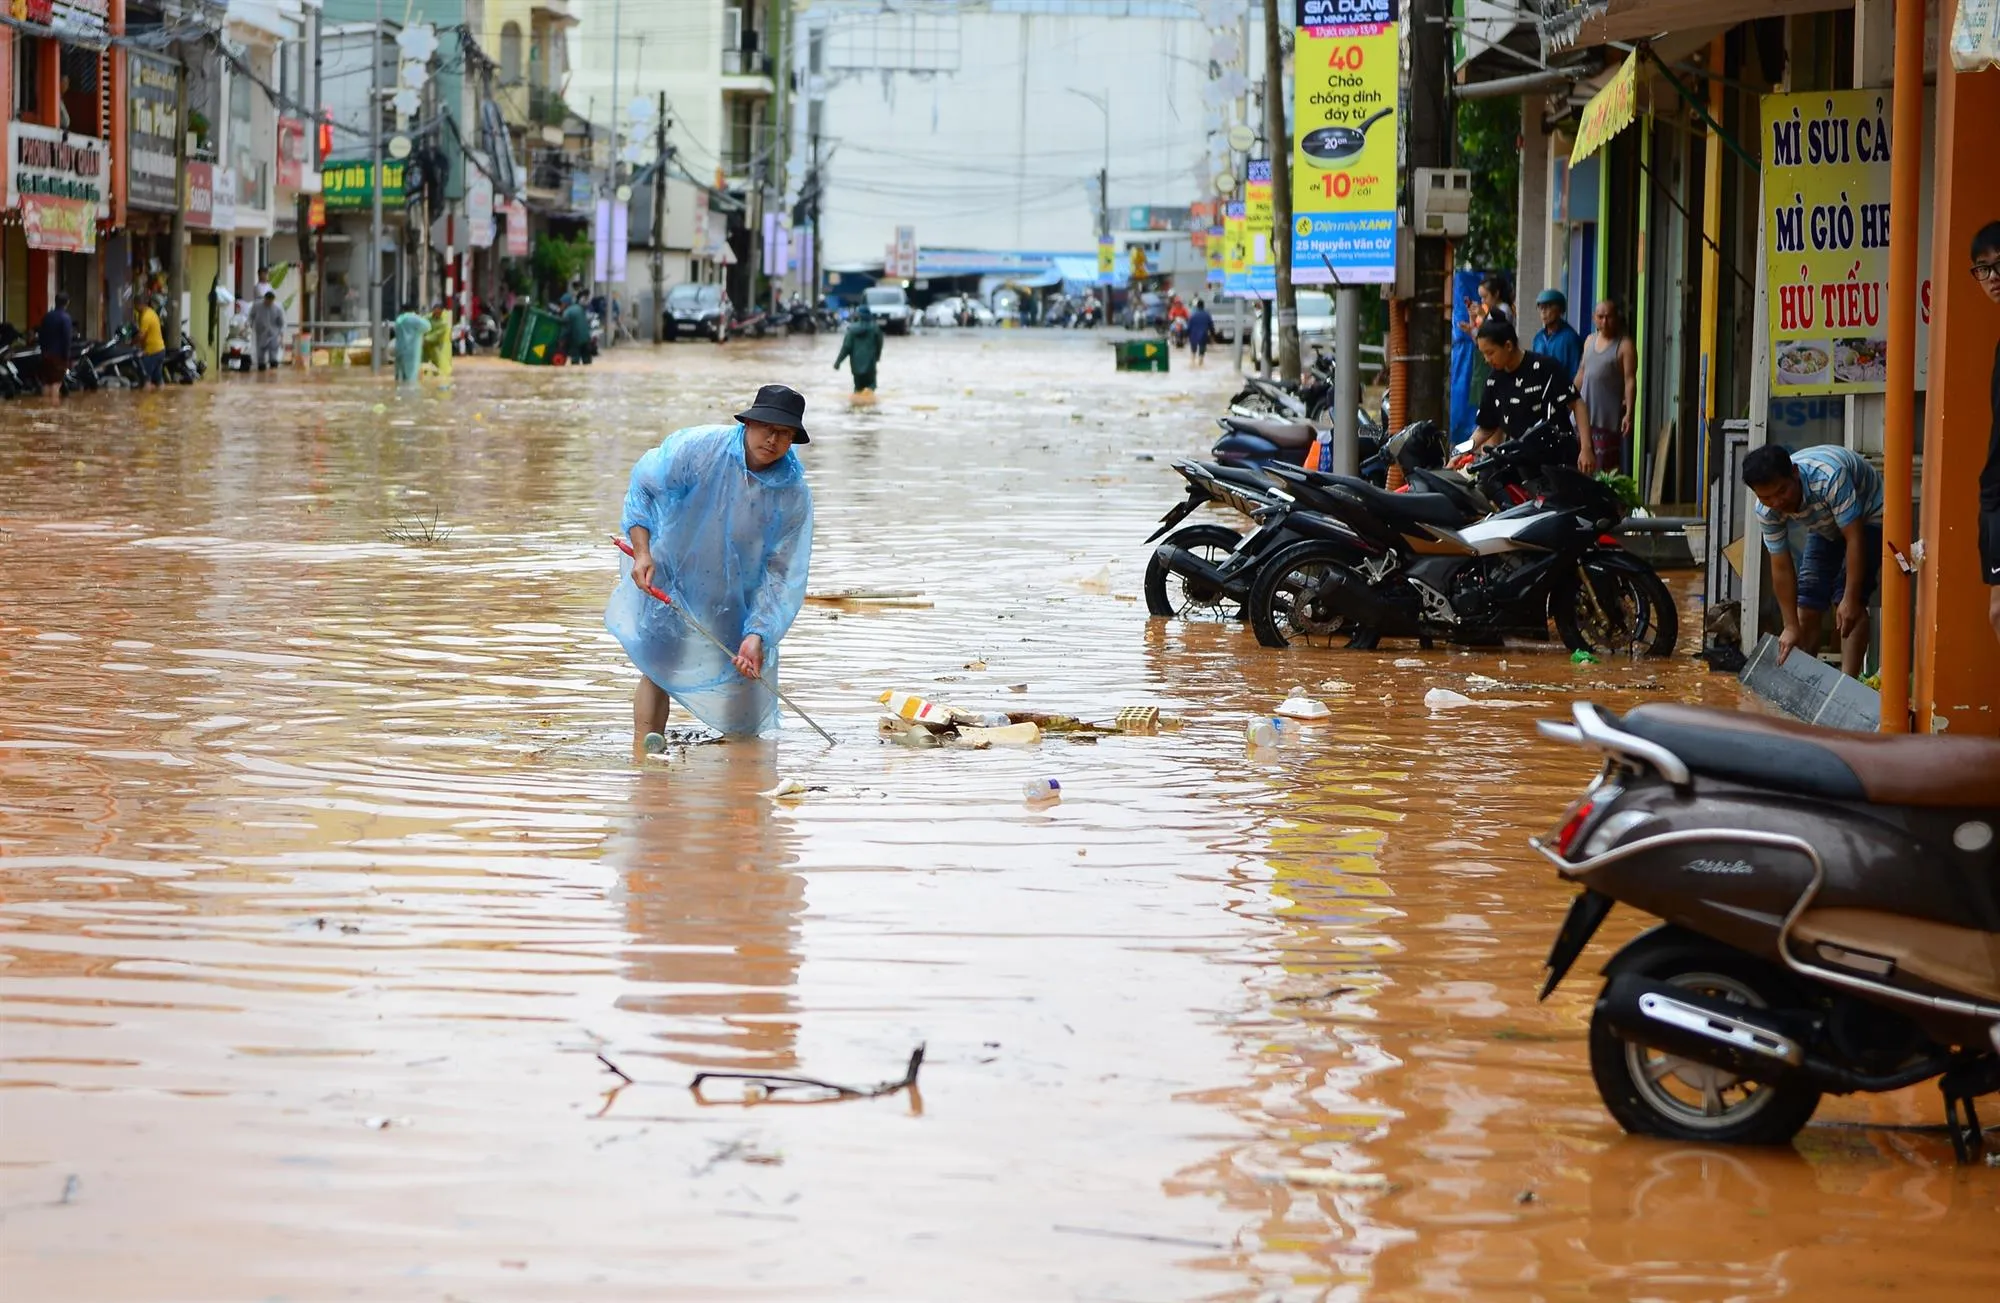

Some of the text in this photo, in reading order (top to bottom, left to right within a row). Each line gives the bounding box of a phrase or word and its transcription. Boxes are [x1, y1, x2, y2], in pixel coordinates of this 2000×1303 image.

[1304, 0, 1389, 14] GIA DỤNG
[1328, 45, 1364, 71] 40
[1328, 73, 1364, 88] Chảo
[1309, 90, 1382, 107] chống dính
[1324, 107, 1367, 123] đáy từ
[1773, 96, 1893, 166] MÌ SỦI CẢ
[323, 163, 366, 192] uỳnh
[1321, 172, 1351, 199] 10
[1775, 191, 1891, 252] MÌ GIÒ HE
[1310, 237, 1351, 252] Nguyễn
[1353, 238, 1374, 249] Văn
[1375, 237, 1392, 249] Cừ
[1779, 264, 1815, 330] HỦ
[1821, 260, 1880, 328] TIẾU
